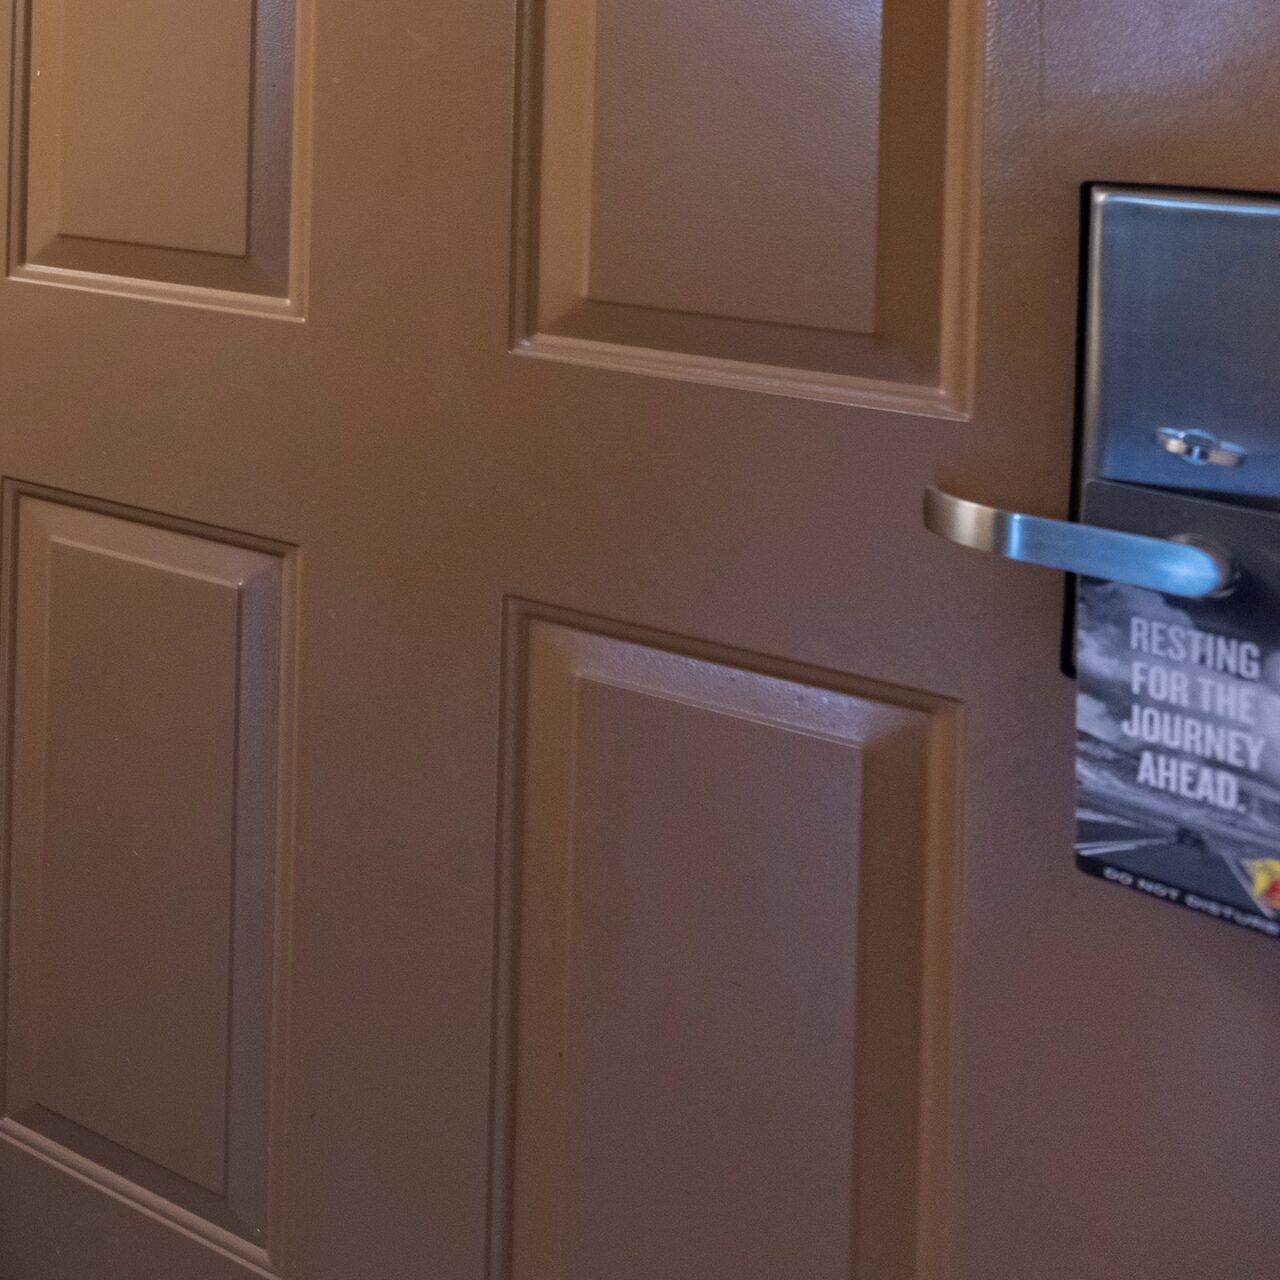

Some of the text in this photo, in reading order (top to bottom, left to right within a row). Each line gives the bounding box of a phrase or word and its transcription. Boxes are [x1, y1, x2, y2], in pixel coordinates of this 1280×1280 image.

[1130, 617, 1261, 680] RESTING
[1131, 661, 1256, 725] FOR THE
[1122, 704, 1266, 772] JOURNEY
[1137, 750, 1247, 813] AHEAD.
[1103, 866, 1279, 936] DO NOT DISTURB
